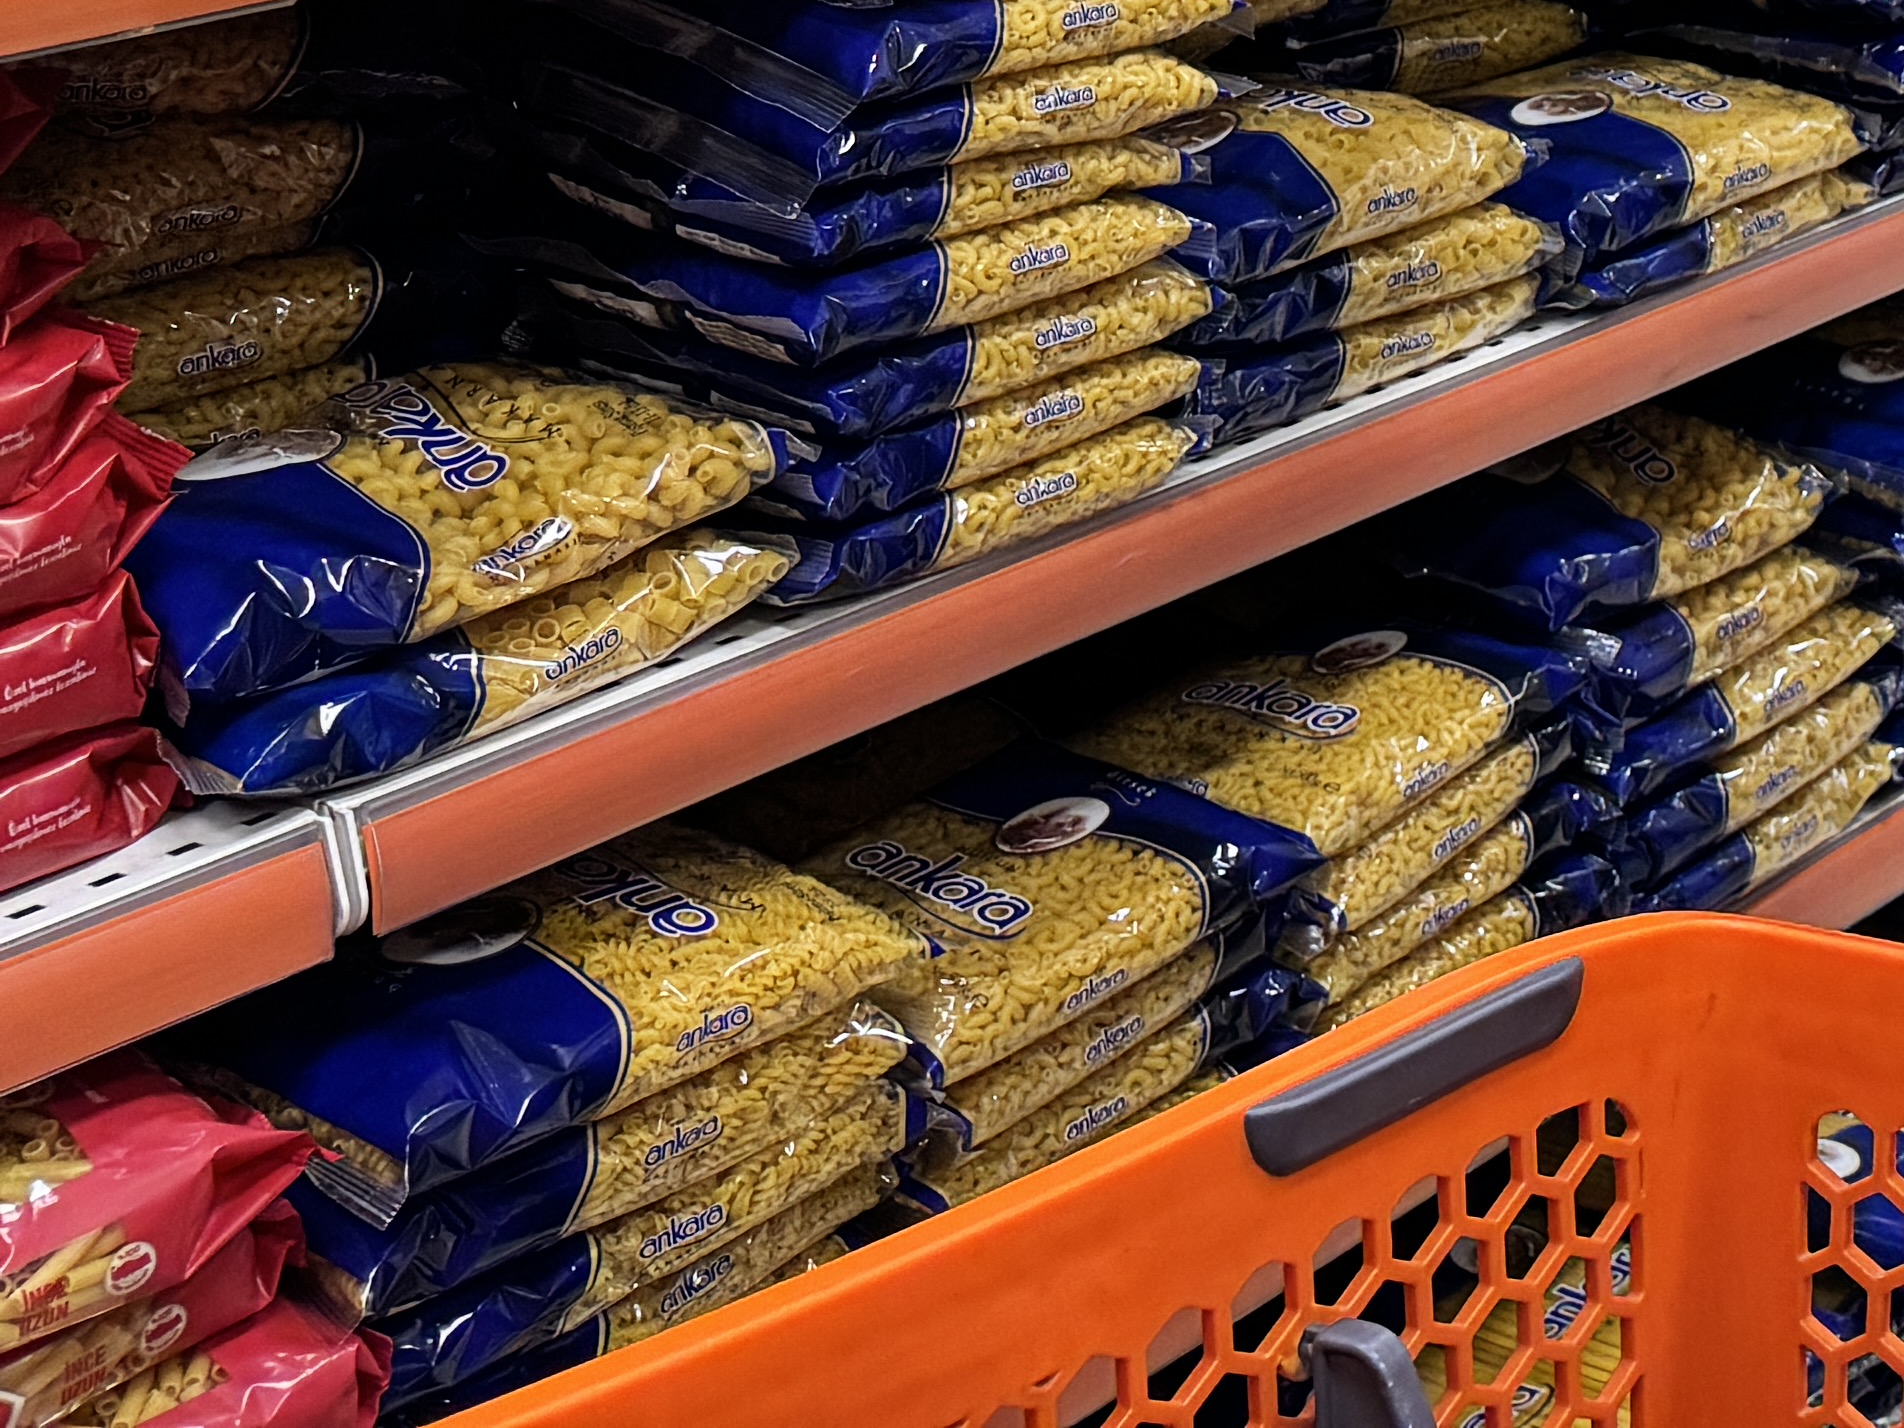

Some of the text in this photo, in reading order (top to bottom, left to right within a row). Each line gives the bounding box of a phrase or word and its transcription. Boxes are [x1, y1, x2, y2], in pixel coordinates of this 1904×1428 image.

[1062, 0, 1118, 29] ankara
[56, 80, 148, 102] ankara
[1033, 83, 1094, 112] ankara
[1012, 160, 1070, 188] ankara
[1723, 163, 1769, 191] ankara
[1367, 184, 1416, 214] ankara
[158, 205, 241, 234] ankara
[139, 248, 220, 281] ankara
[1009, 242, 1068, 274] ankara
[1386, 260, 1439, 287] ankara
[1035, 316, 1094, 350] ankara
[1381, 330, 1433, 356] ankara
[179, 341, 260, 376] ankara
[1024, 392, 1081, 425] ankara
[1016, 471, 1075, 508] ankara
[1716, 607, 1763, 640] ankara
[545, 627, 622, 681] ankara
[1183, 679, 1359, 734] ankara
[1401, 761, 1448, 799] ankara
[1434, 816, 1480, 858] ankara
[846, 841, 1032, 934] ankara
[1066, 968, 1128, 1012] ankara
[677, 1004, 751, 1052] ankara
[1086, 1016, 1144, 1063] ankara
[1065, 1096, 1127, 1142] ankara
[645, 1115, 722, 1167] ankara
[640, 1203, 726, 1258] ankara
[661, 1254, 732, 1315] ankara
